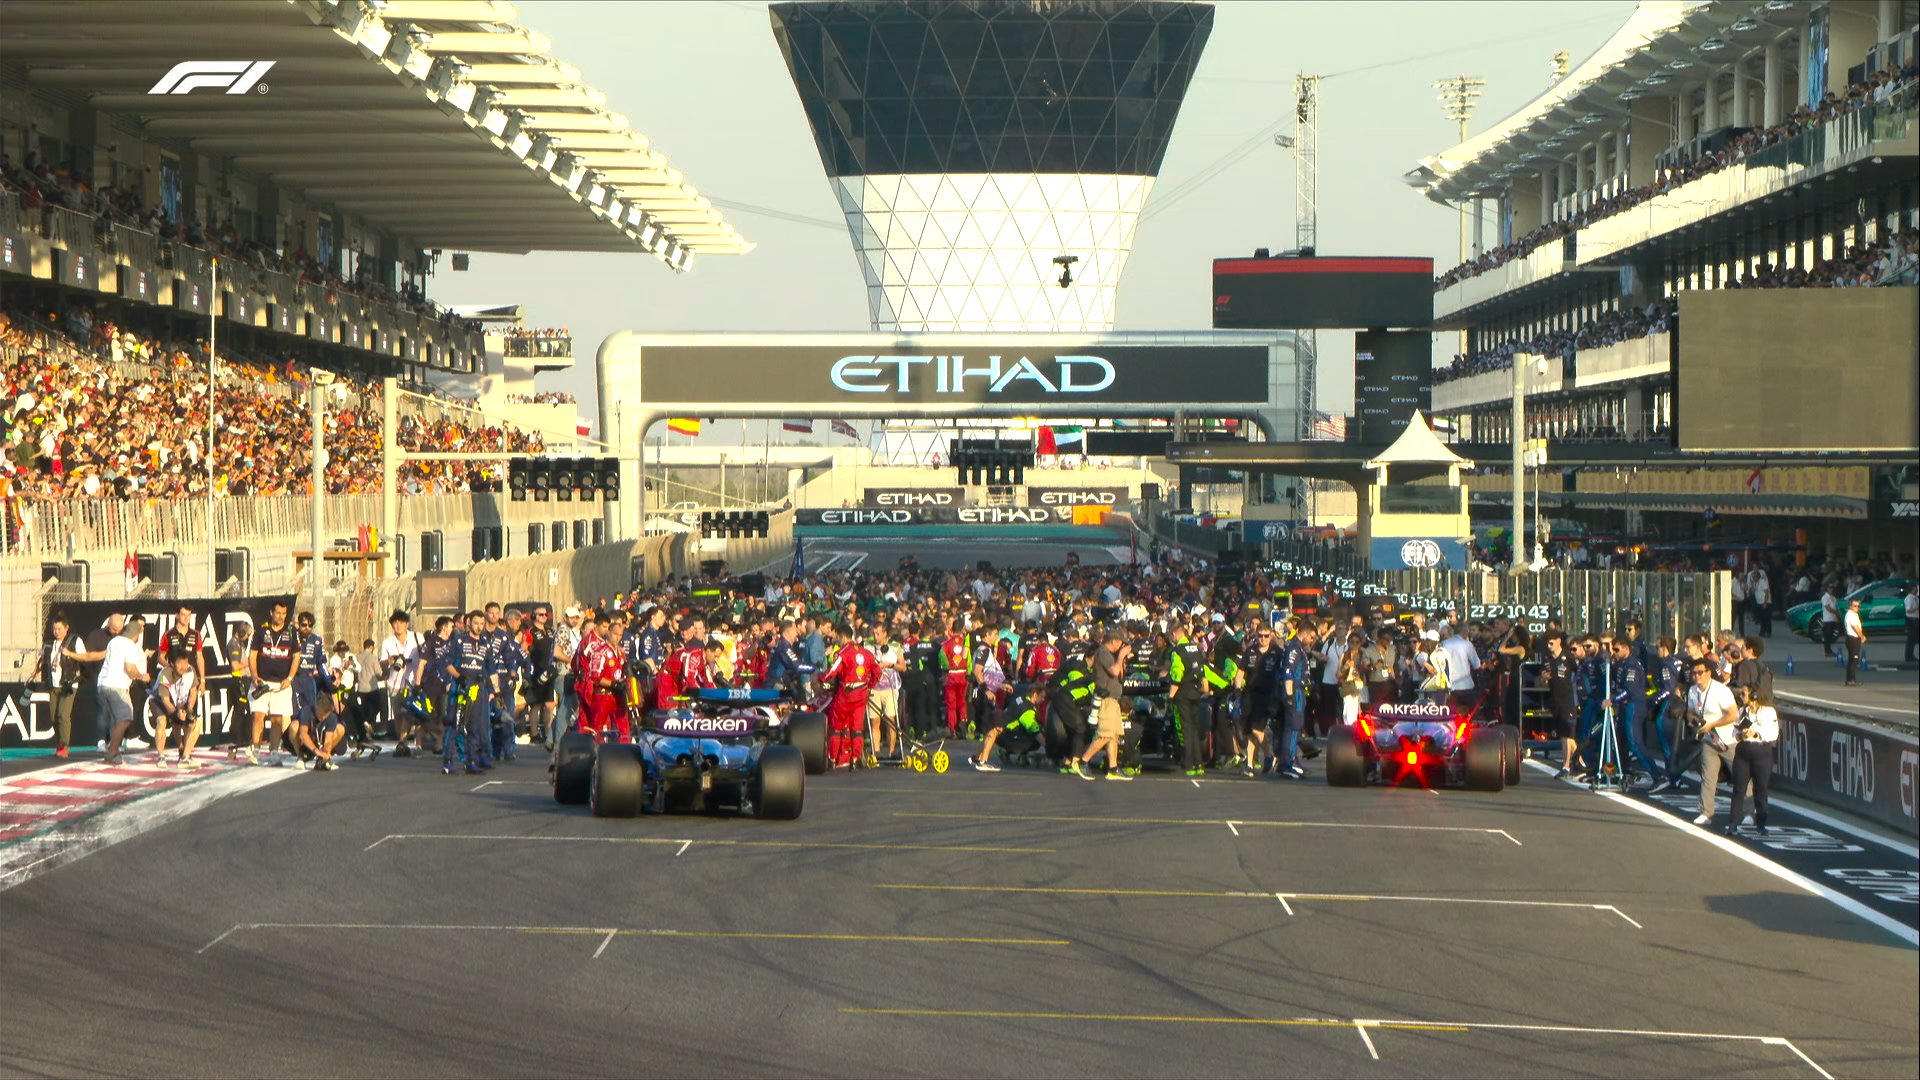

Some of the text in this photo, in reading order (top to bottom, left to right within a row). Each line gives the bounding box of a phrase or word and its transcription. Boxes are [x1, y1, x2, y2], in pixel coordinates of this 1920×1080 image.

[831, 355, 1116, 393] ETIHAD
[877, 493, 952, 505] ETIHAD
[1041, 492, 1116, 504] ETIHAD
[821, 510, 912, 523] ETIHAD
[959, 508, 1049, 522] ETIHAD
[1341, 579, 1356, 589] 22
[1507, 605, 1526, 618] 10
[1528, 605, 1550, 619] 43
[728, 689, 752, 699] IBM
[1830, 730, 1875, 803] ETIHAD
